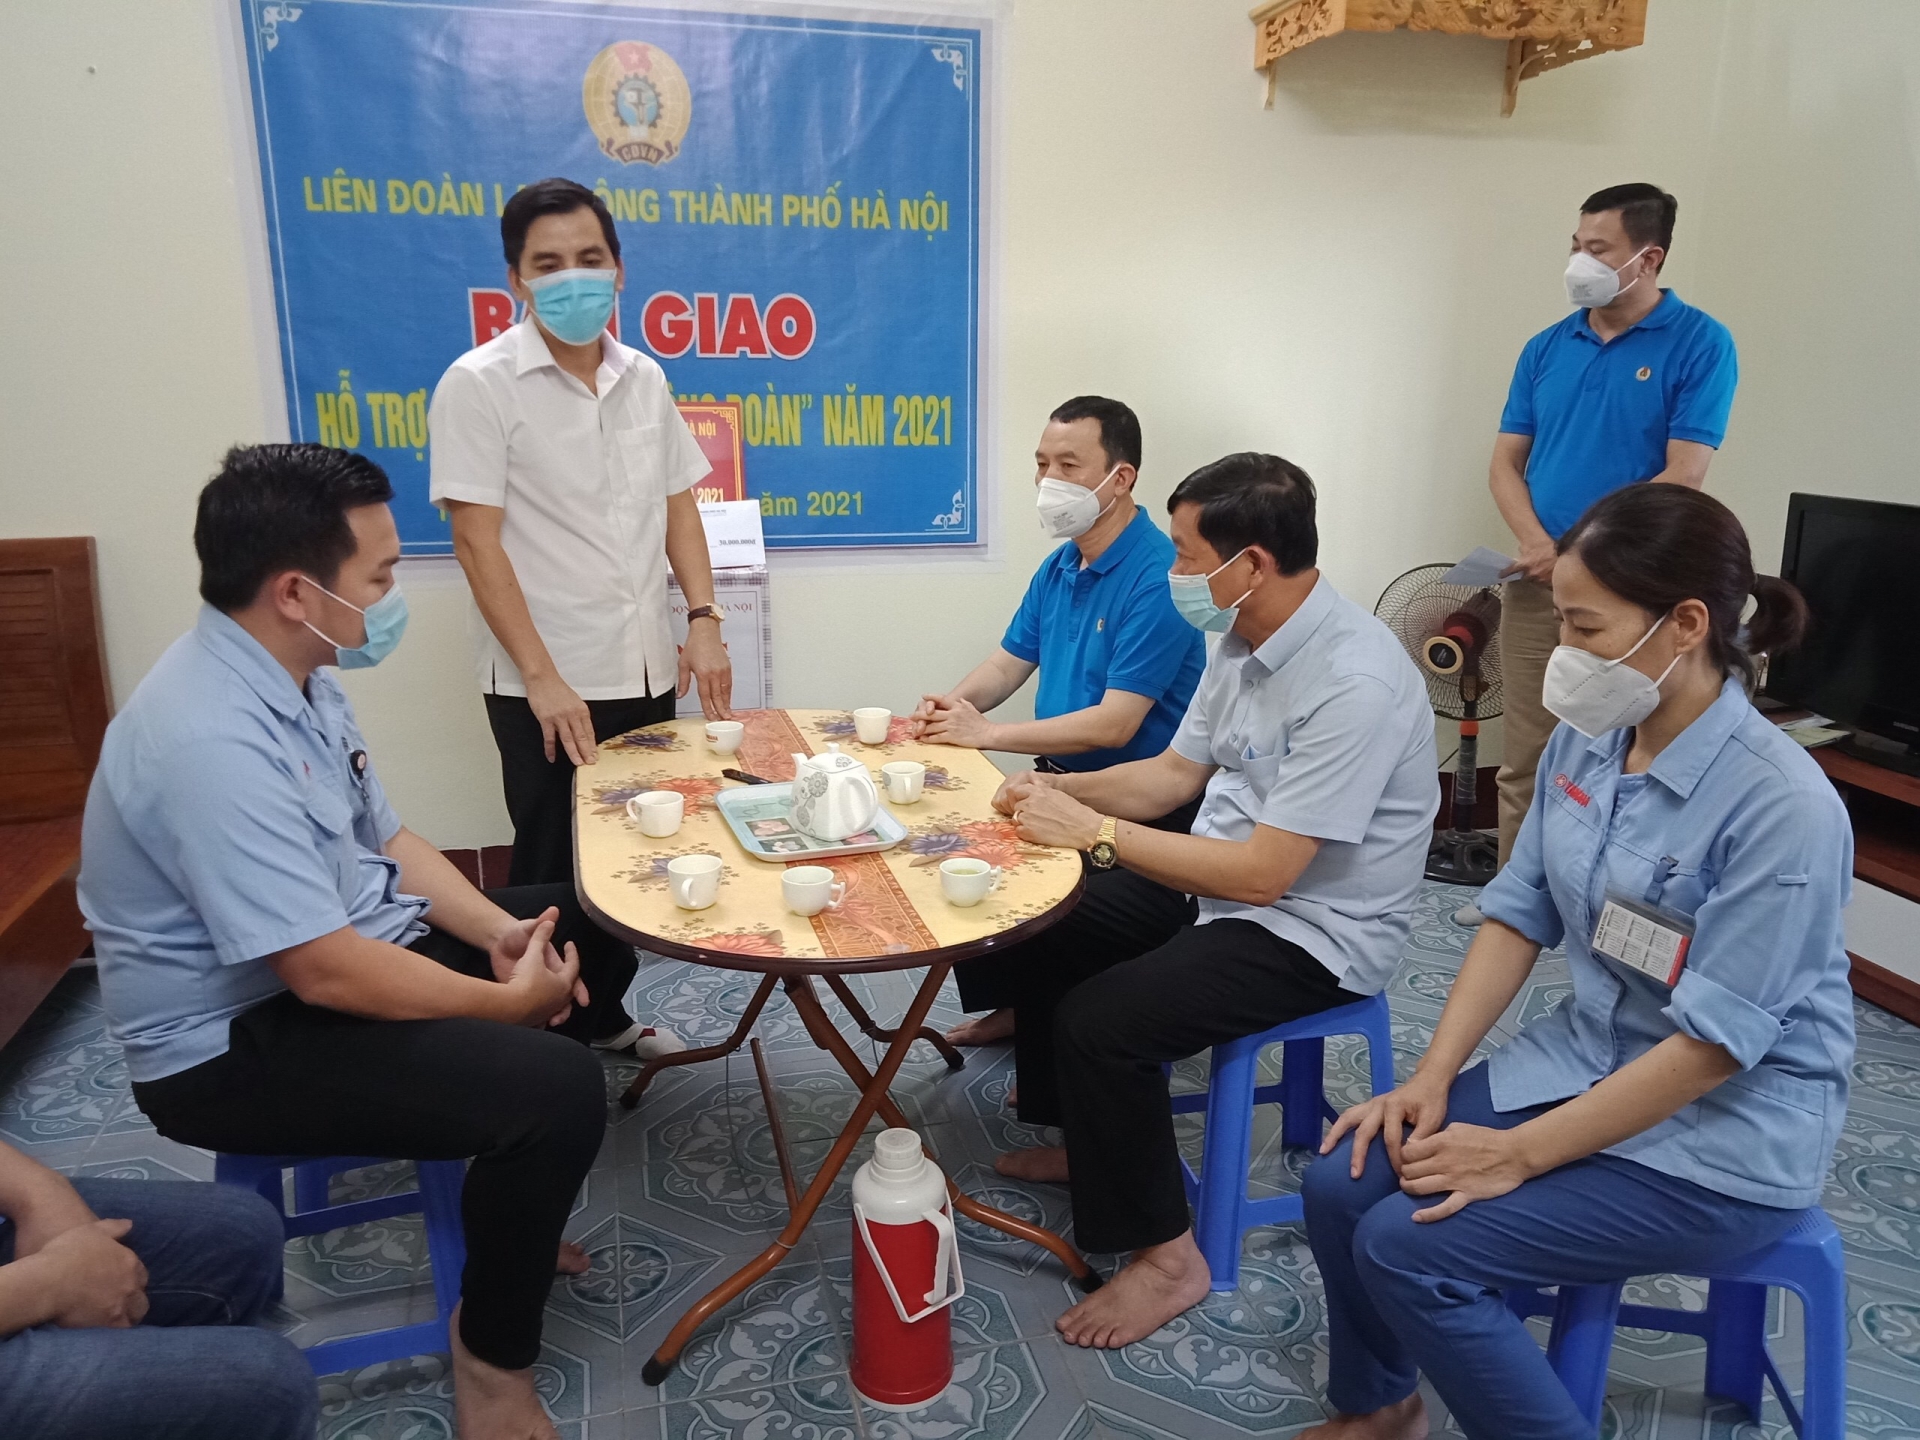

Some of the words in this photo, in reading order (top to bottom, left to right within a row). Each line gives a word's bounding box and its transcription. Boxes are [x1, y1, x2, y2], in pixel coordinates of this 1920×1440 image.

[303, 167, 377, 213] LIÊN
[386, 172, 484, 217] ĐOÀN
[669, 182, 772, 226] THÀNH
[782, 180, 842, 229] PHỐ
[851, 189, 891, 230] HÀ
[899, 191, 948, 241] NỘI
[641, 291, 817, 360] GIAO
[315, 369, 360, 449] HỖ
[366, 388, 427, 461] TRỢ
[684, 419, 697, 437] À
[698, 419, 717, 440] NỘI
[823, 383, 885, 447] NĂM
[893, 395, 952, 447] 2021
[697, 487, 725, 504] 2021
[759, 491, 798, 517] ăm
[807, 491, 862, 517] 2021
